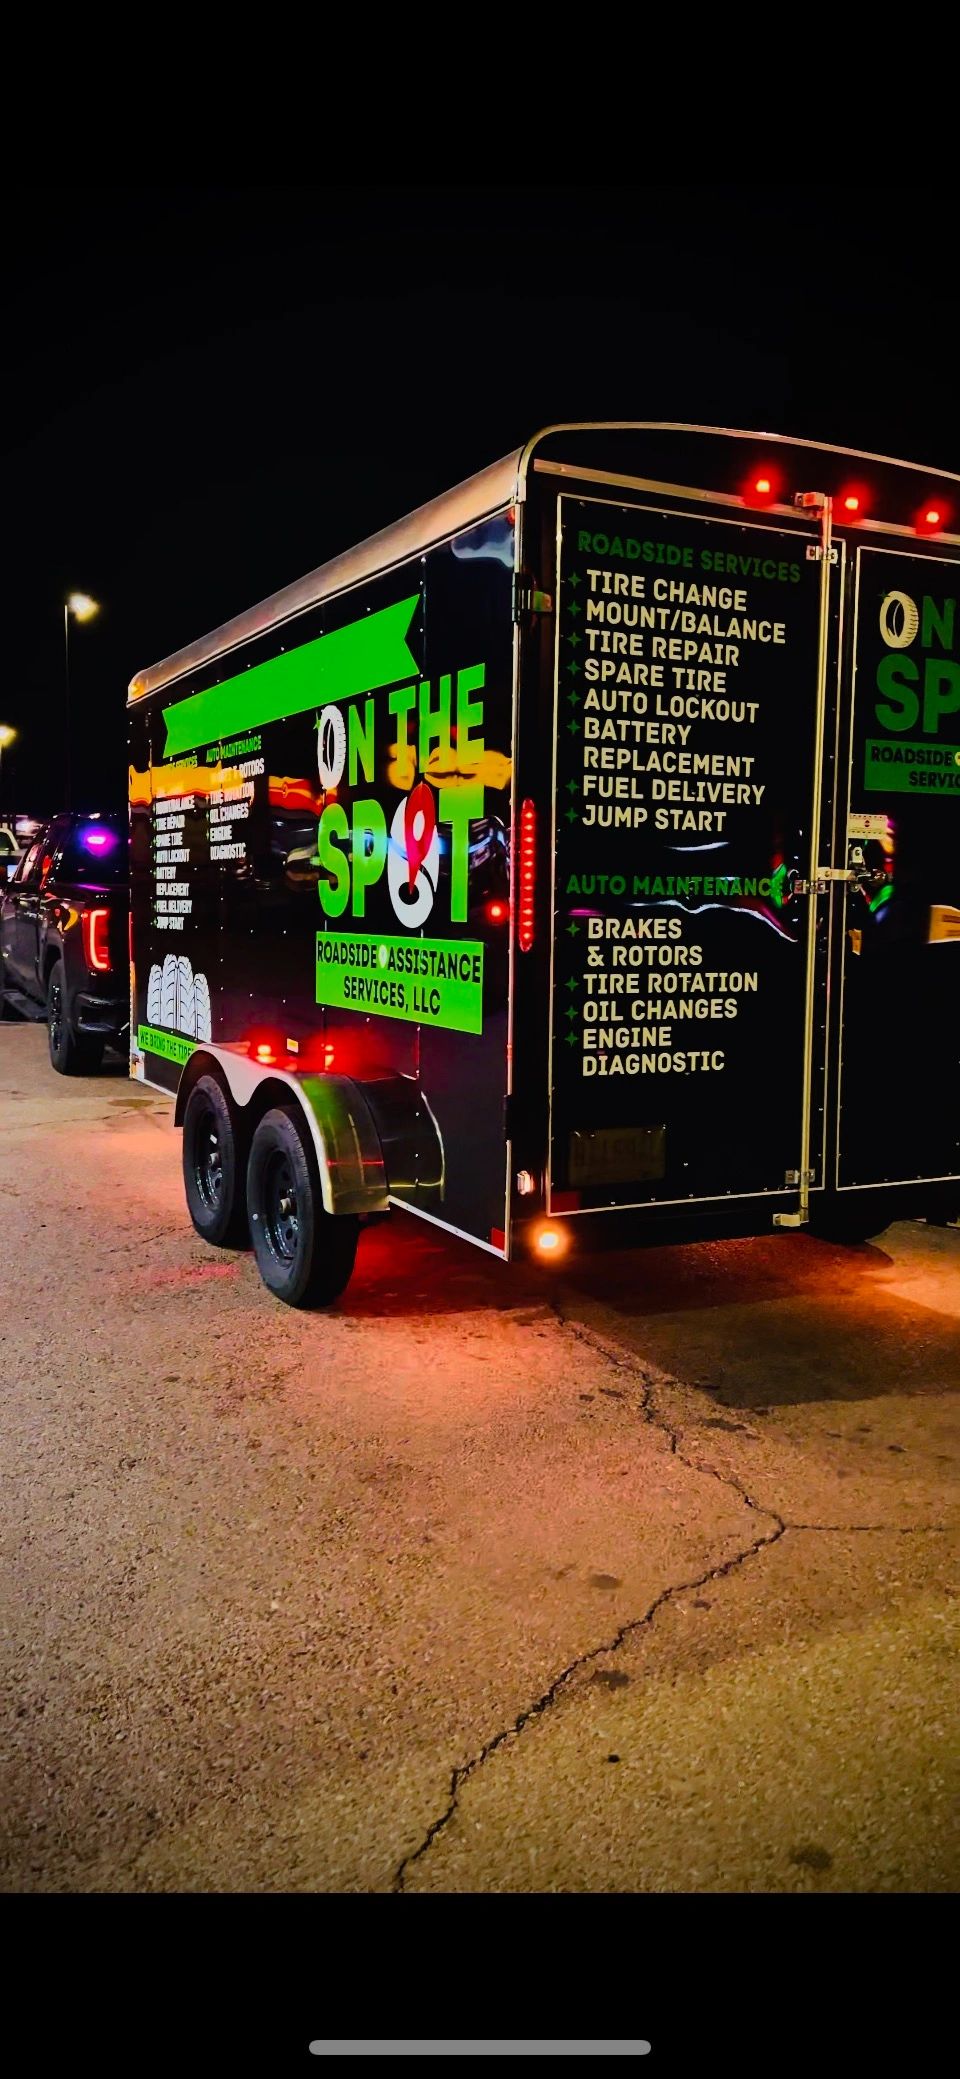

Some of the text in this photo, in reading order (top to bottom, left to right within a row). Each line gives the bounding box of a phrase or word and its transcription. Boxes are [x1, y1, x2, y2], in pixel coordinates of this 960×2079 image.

[578, 531, 801, 583] ROADSIDE SERVICES
[586, 569, 747, 612] TIRE CHANGE
[586, 600, 786, 644] MOUNT/BALANCE
[879, 590, 955, 650] ON
[585, 629, 740, 667] TIRE REPAIR
[584, 658, 726, 693] SPARE TIRE
[583, 688, 759, 723] AUTO LOCKOUT
[875, 654, 960, 732] SP
[318, 663, 485, 790] ON THE
[584, 717, 692, 745] BATTERY
[583, 747, 755, 778] REPLACEMENT
[871, 746, 952, 767] ROADSIDE
[583, 775, 765, 805] FUEL DELIVERY
[909, 771, 960, 789] SERVIC
[582, 804, 727, 831] JUMP START
[318, 783, 484, 928] SPOT
[566, 875, 783, 897] AUTO MAINTENANCE
[588, 918, 682, 939] BRAKES
[318, 940, 481, 983] ROADSIDE ASSISTANCE
[587, 945, 703, 966] & ROTORS
[343, 976, 440, 1015] SERVICES, LLC
[583, 972, 758, 994] TIRE ROTATION
[583, 998, 738, 1022] OIL CHANGES
[140, 1032, 194, 1061] WE BRING THE TIRE
[583, 1026, 672, 1049] ENGINE
[583, 1051, 725, 1076] DIAGNOSTIC
